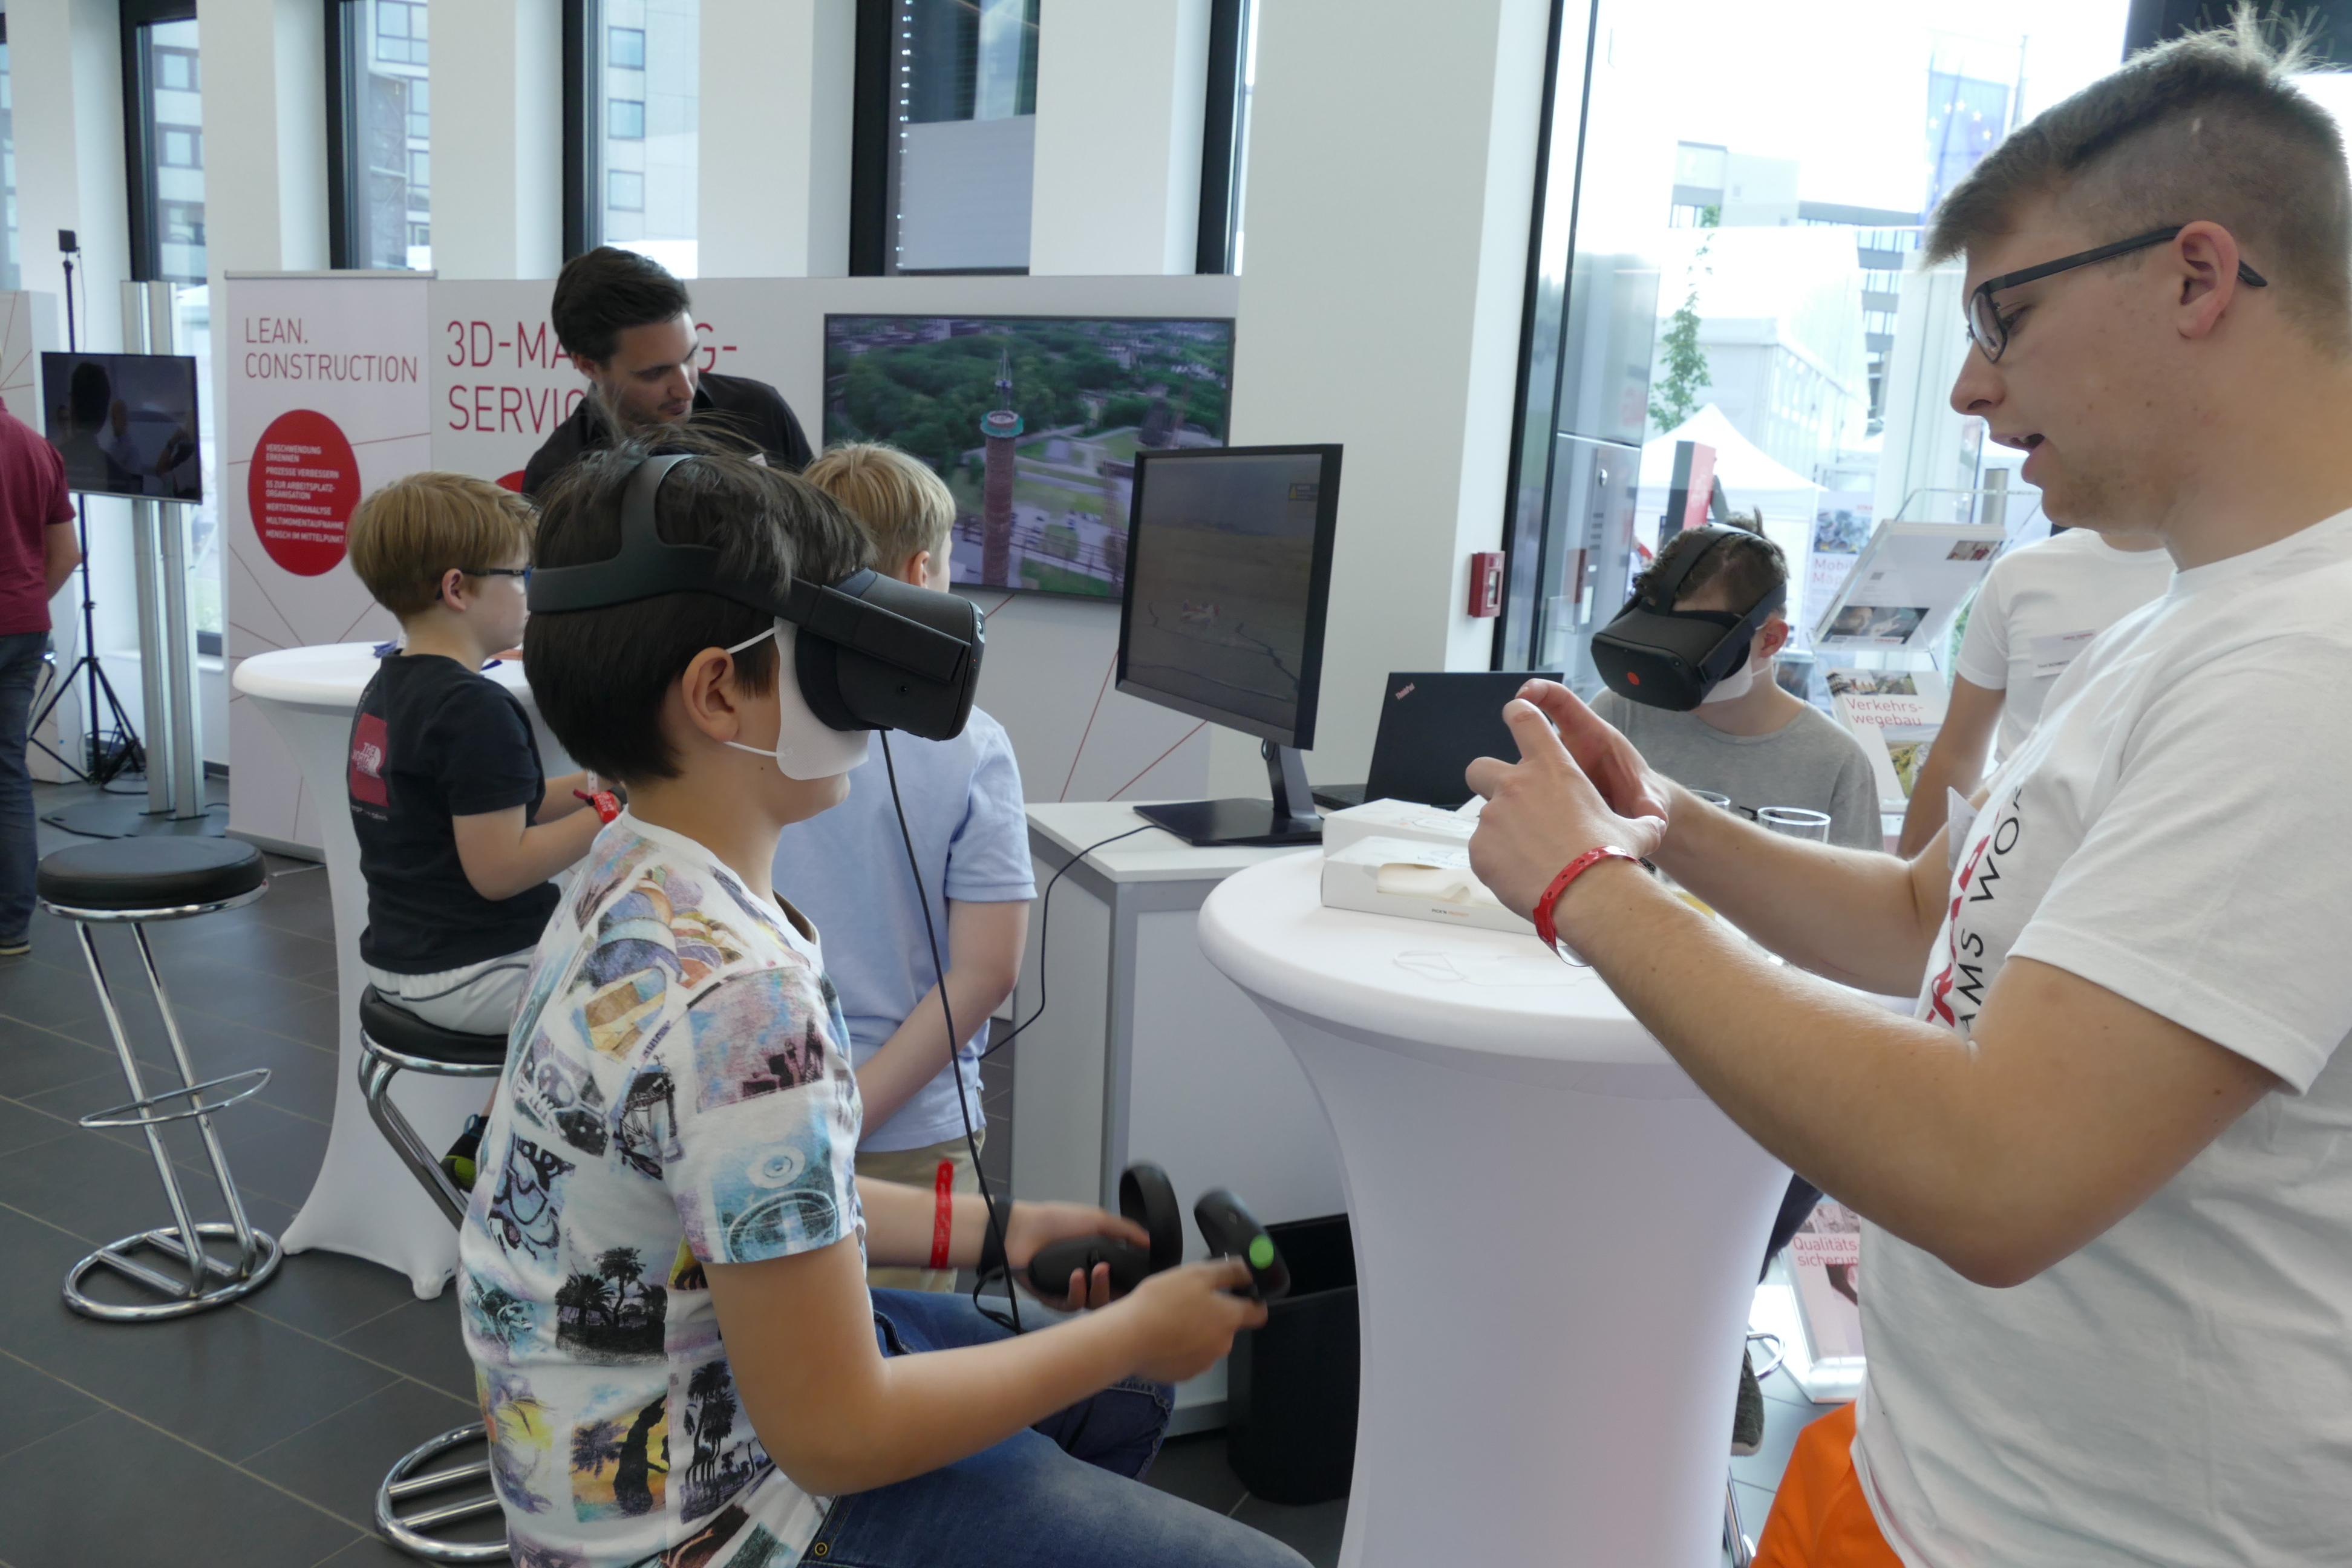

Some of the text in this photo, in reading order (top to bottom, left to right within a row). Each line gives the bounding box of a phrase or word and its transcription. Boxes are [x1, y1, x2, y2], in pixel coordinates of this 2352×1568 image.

[246, 317, 308, 344] LEAN.
[447, 321, 737, 373] 3D-MAG-
[245, 353, 417, 383] CONSTRUCTION
[266, 443, 322, 455] VERSCHWENDUNG
[266, 453, 300, 463] ERKENNEN
[266, 466, 340, 479] PROZESSE VERBESSERN
[273, 480, 286, 489] ZUR
[287, 482, 336, 492] ARBEITSPLATZ-
[266, 489, 311, 500] ORGANISATION
[265, 503, 332, 516] WERTSTROMANALYSE
[266, 516, 344, 531] MULTIMOMENTAUFNAHME
[266, 529, 345, 543] MENSCH IM MITTELPUNKT
[1846, 697, 1924, 713] Verkehrs-
[1851, 714, 1922, 728] wegebau
[364, 742, 376, 754] THE
